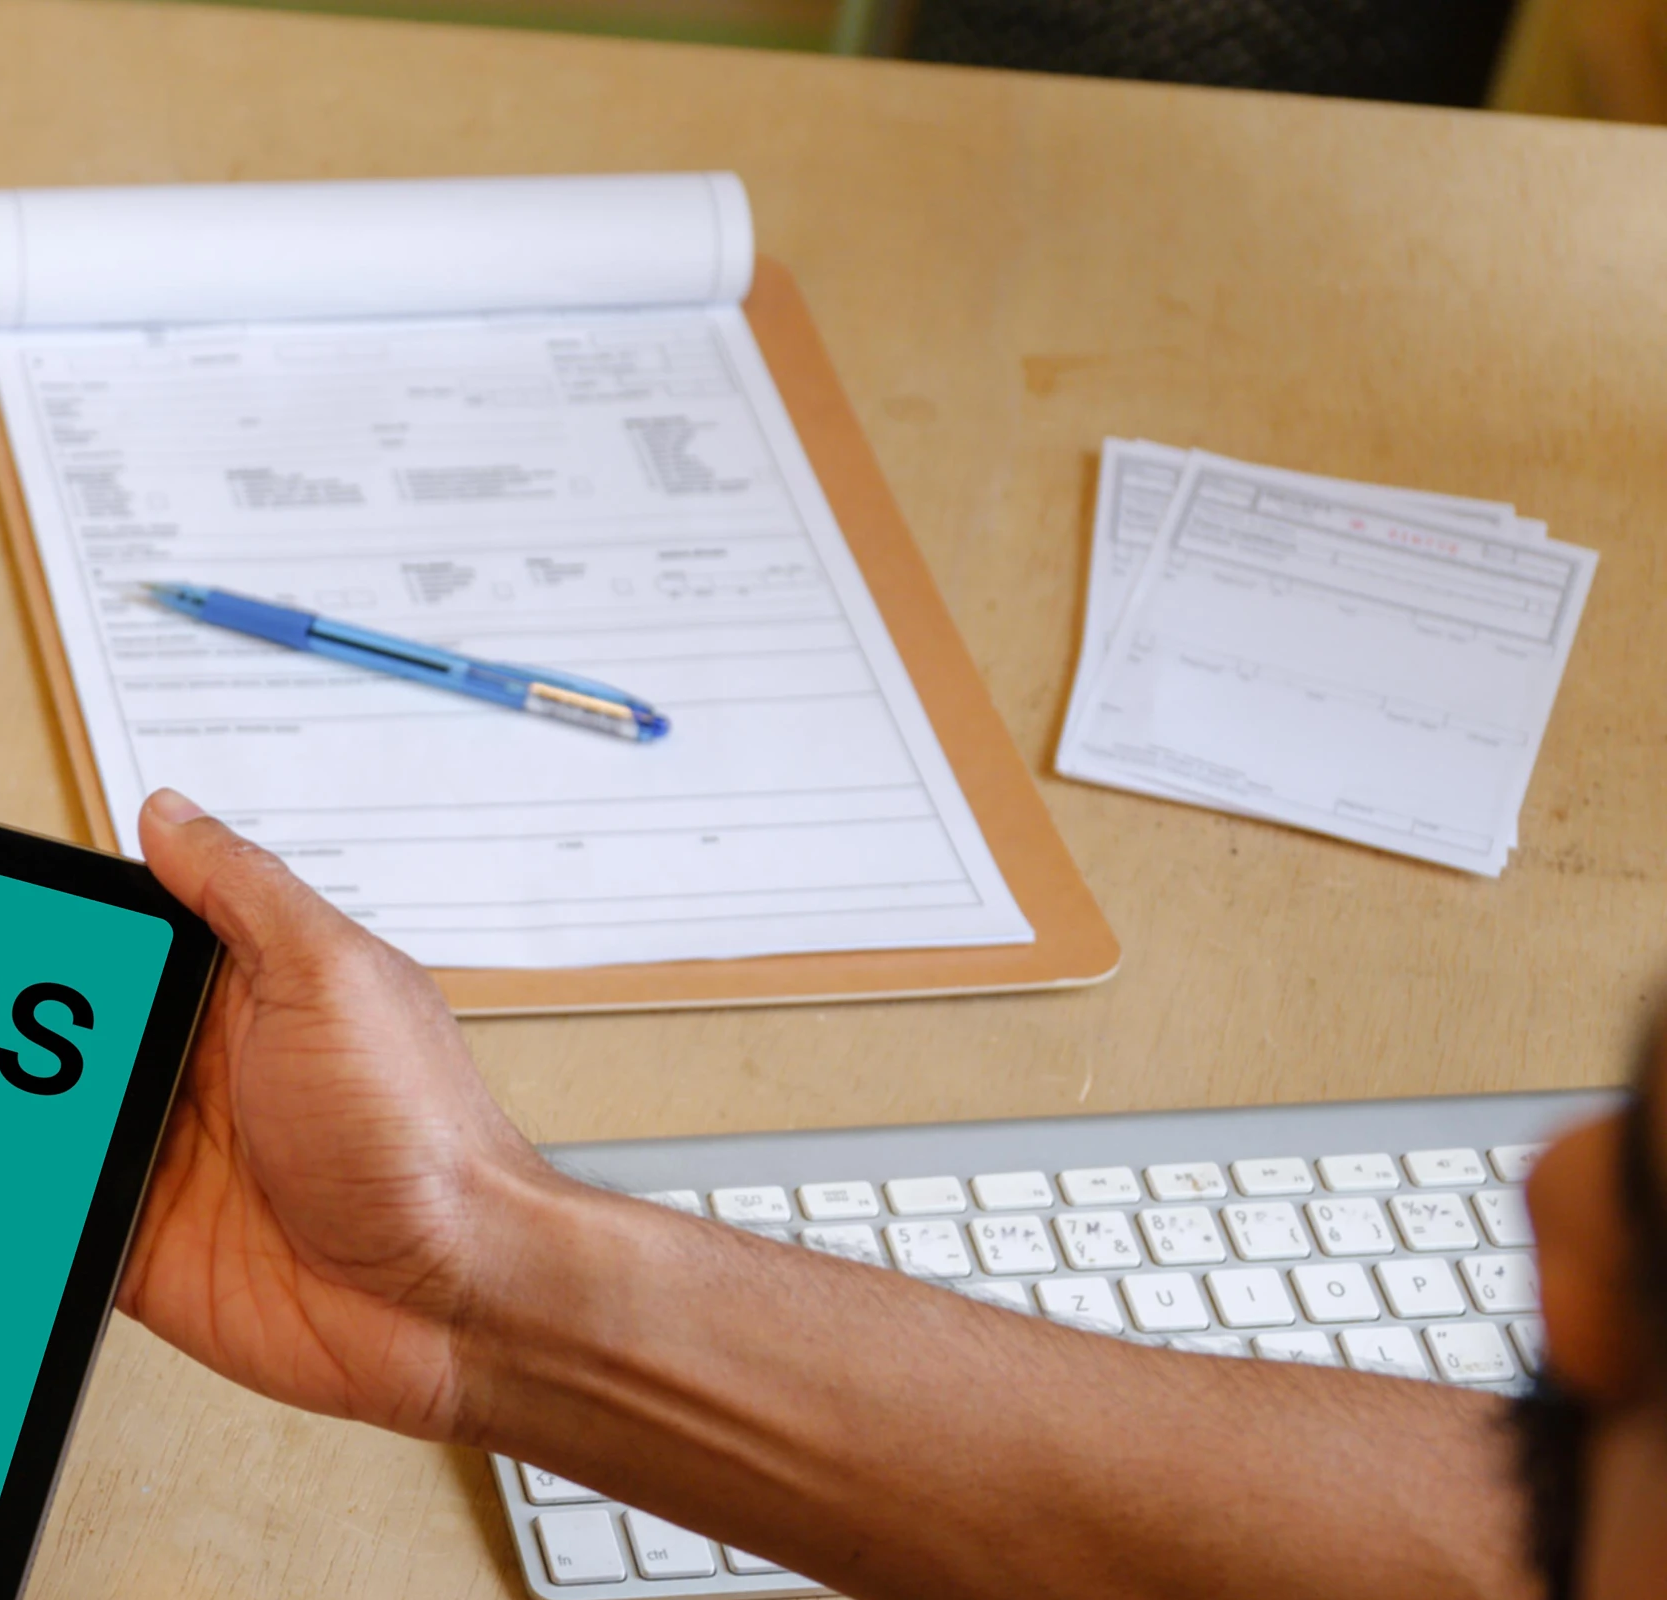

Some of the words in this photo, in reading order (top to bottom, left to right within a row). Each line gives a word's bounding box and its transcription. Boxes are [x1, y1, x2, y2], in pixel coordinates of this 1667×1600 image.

[898, 1228, 911, 1243] 5
[983, 1225, 995, 1239] 6
[1066, 1220, 1077, 1235] 7
[1152, 1215, 1165, 1231] 8
[1235, 1210, 1247, 1225] 9
[1319, 1205, 1333, 1221] 0
[1113, 1239, 1130, 1253] &
[1071, 1295, 1090, 1312] Z
[1156, 1290, 1175, 1307] U
[1246, 1286, 1256, 1302] I
[1327, 1281, 1346, 1298] O
[1412, 1276, 1427, 1293] P
[1378, 1346, 1394, 1362] L
[557, 1553, 573, 1567] fn
[646, 1548, 669, 1562] ctrl
